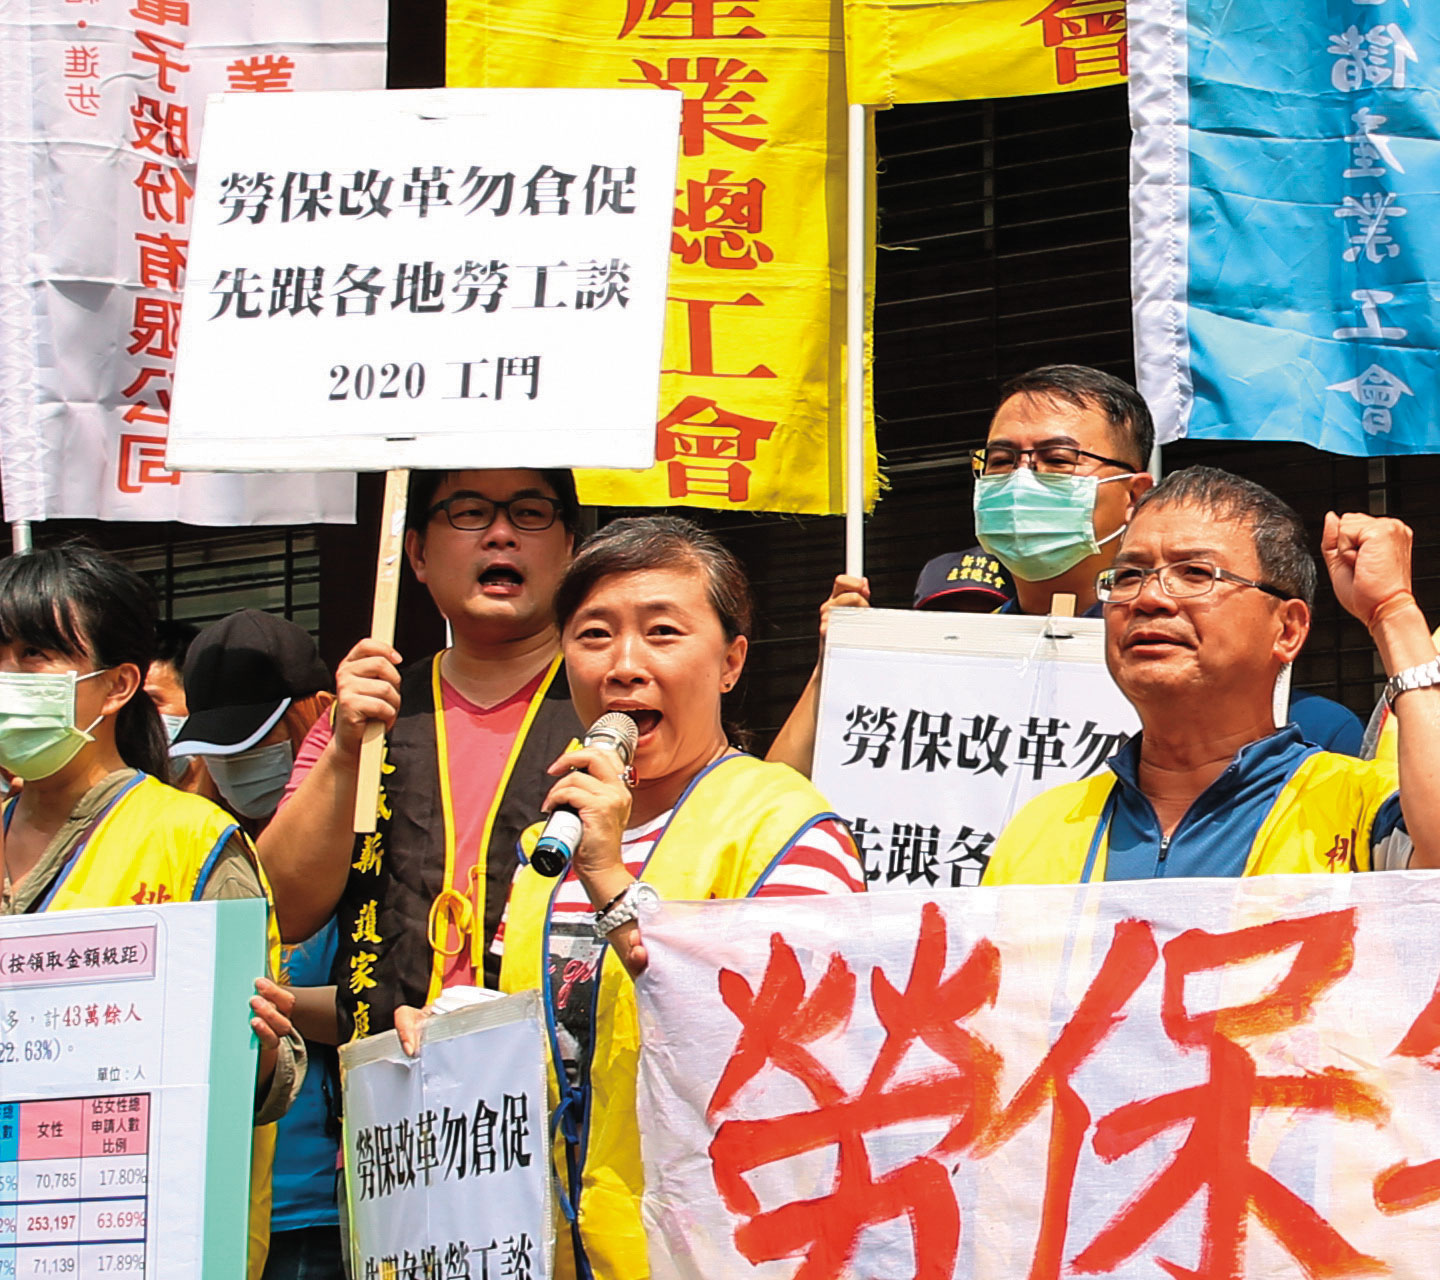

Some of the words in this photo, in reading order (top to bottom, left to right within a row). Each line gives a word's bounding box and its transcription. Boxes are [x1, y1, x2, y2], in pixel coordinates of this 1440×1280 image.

[219, 164, 638, 226] 勞保改革勿倉促
[208, 259, 632, 322] 先跟各地勞工談
[328, 362, 426, 402] 2020
[356, 1093, 532, 1202] 勞保改革勿倉促
[36, 1173, 77, 1189] 70,785
[99, 1167, 148, 1186] 17.80%
[27, 1215, 76, 1232] 253,197
[97, 1210, 146, 1229] 63.69%
[34, 1258, 75, 1274] 71,139
[97, 1254, 146, 1272] 17.89%
